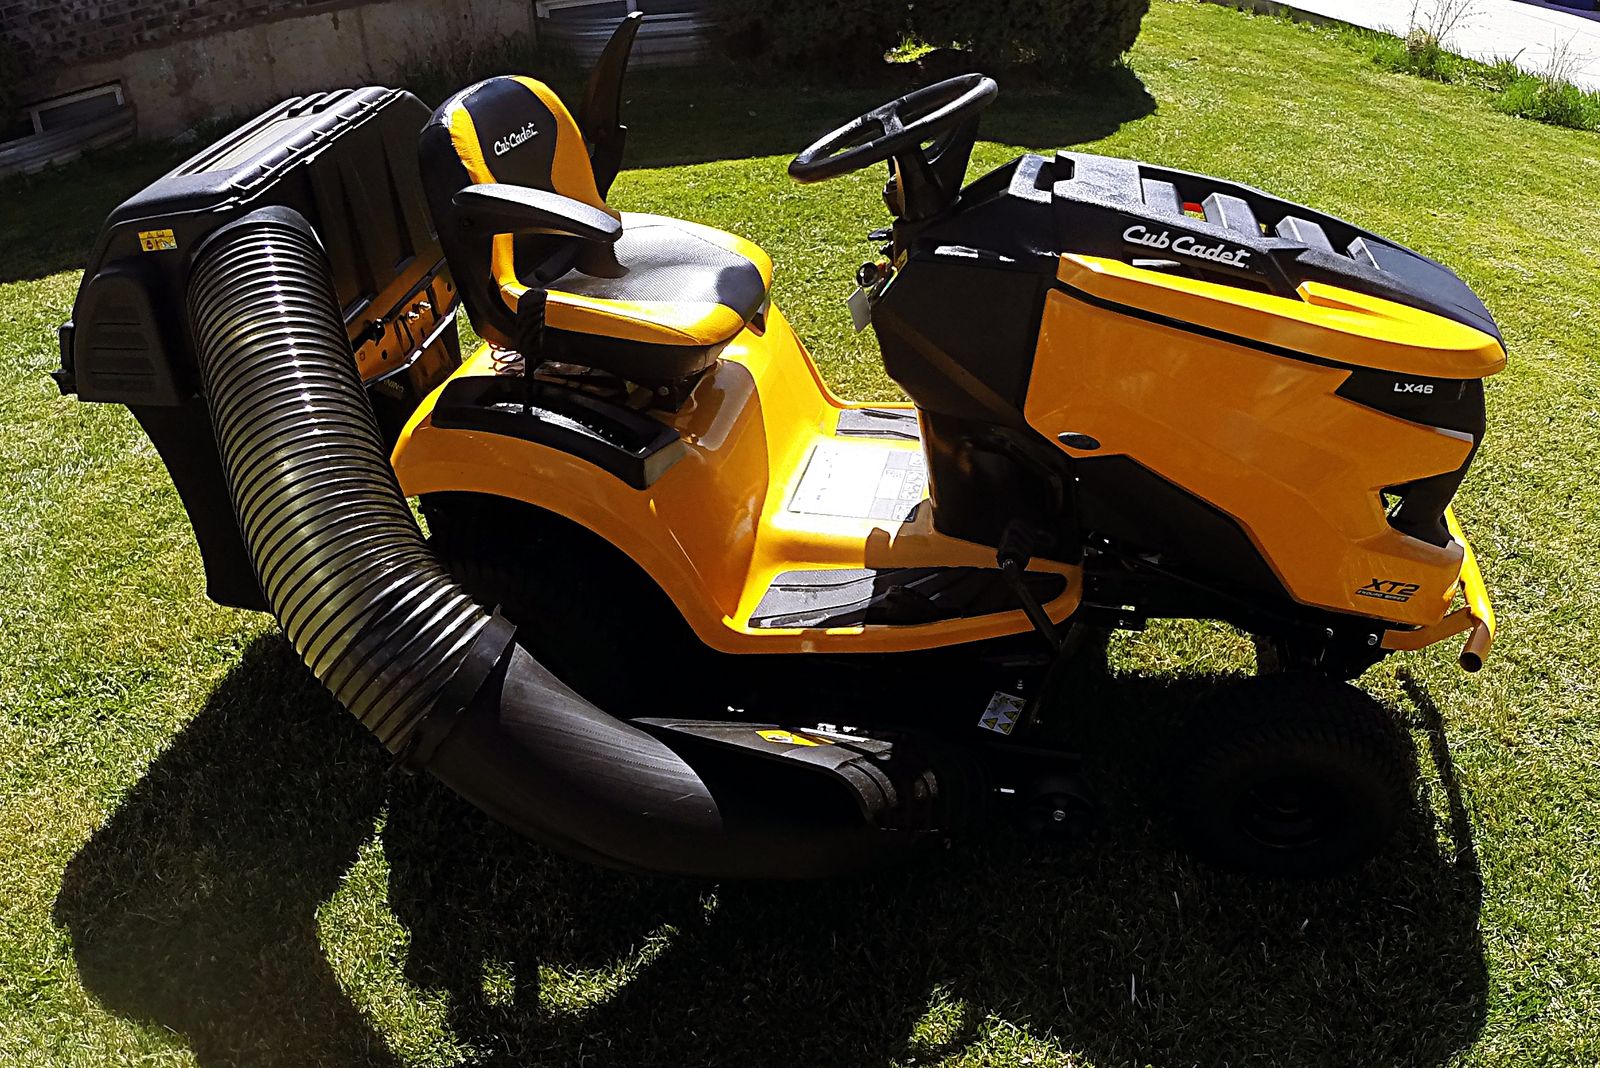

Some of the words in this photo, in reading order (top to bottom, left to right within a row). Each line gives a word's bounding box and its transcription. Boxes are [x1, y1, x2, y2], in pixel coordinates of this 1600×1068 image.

[494, 136, 510, 156] Cub
[509, 121, 539, 148] Cadet
[1123, 225, 1170, 249] Cub
[1171, 236, 1251, 269] Cadet
[1393, 382, 1434, 394] LX46
[1361, 578, 1420, 596] XT2
